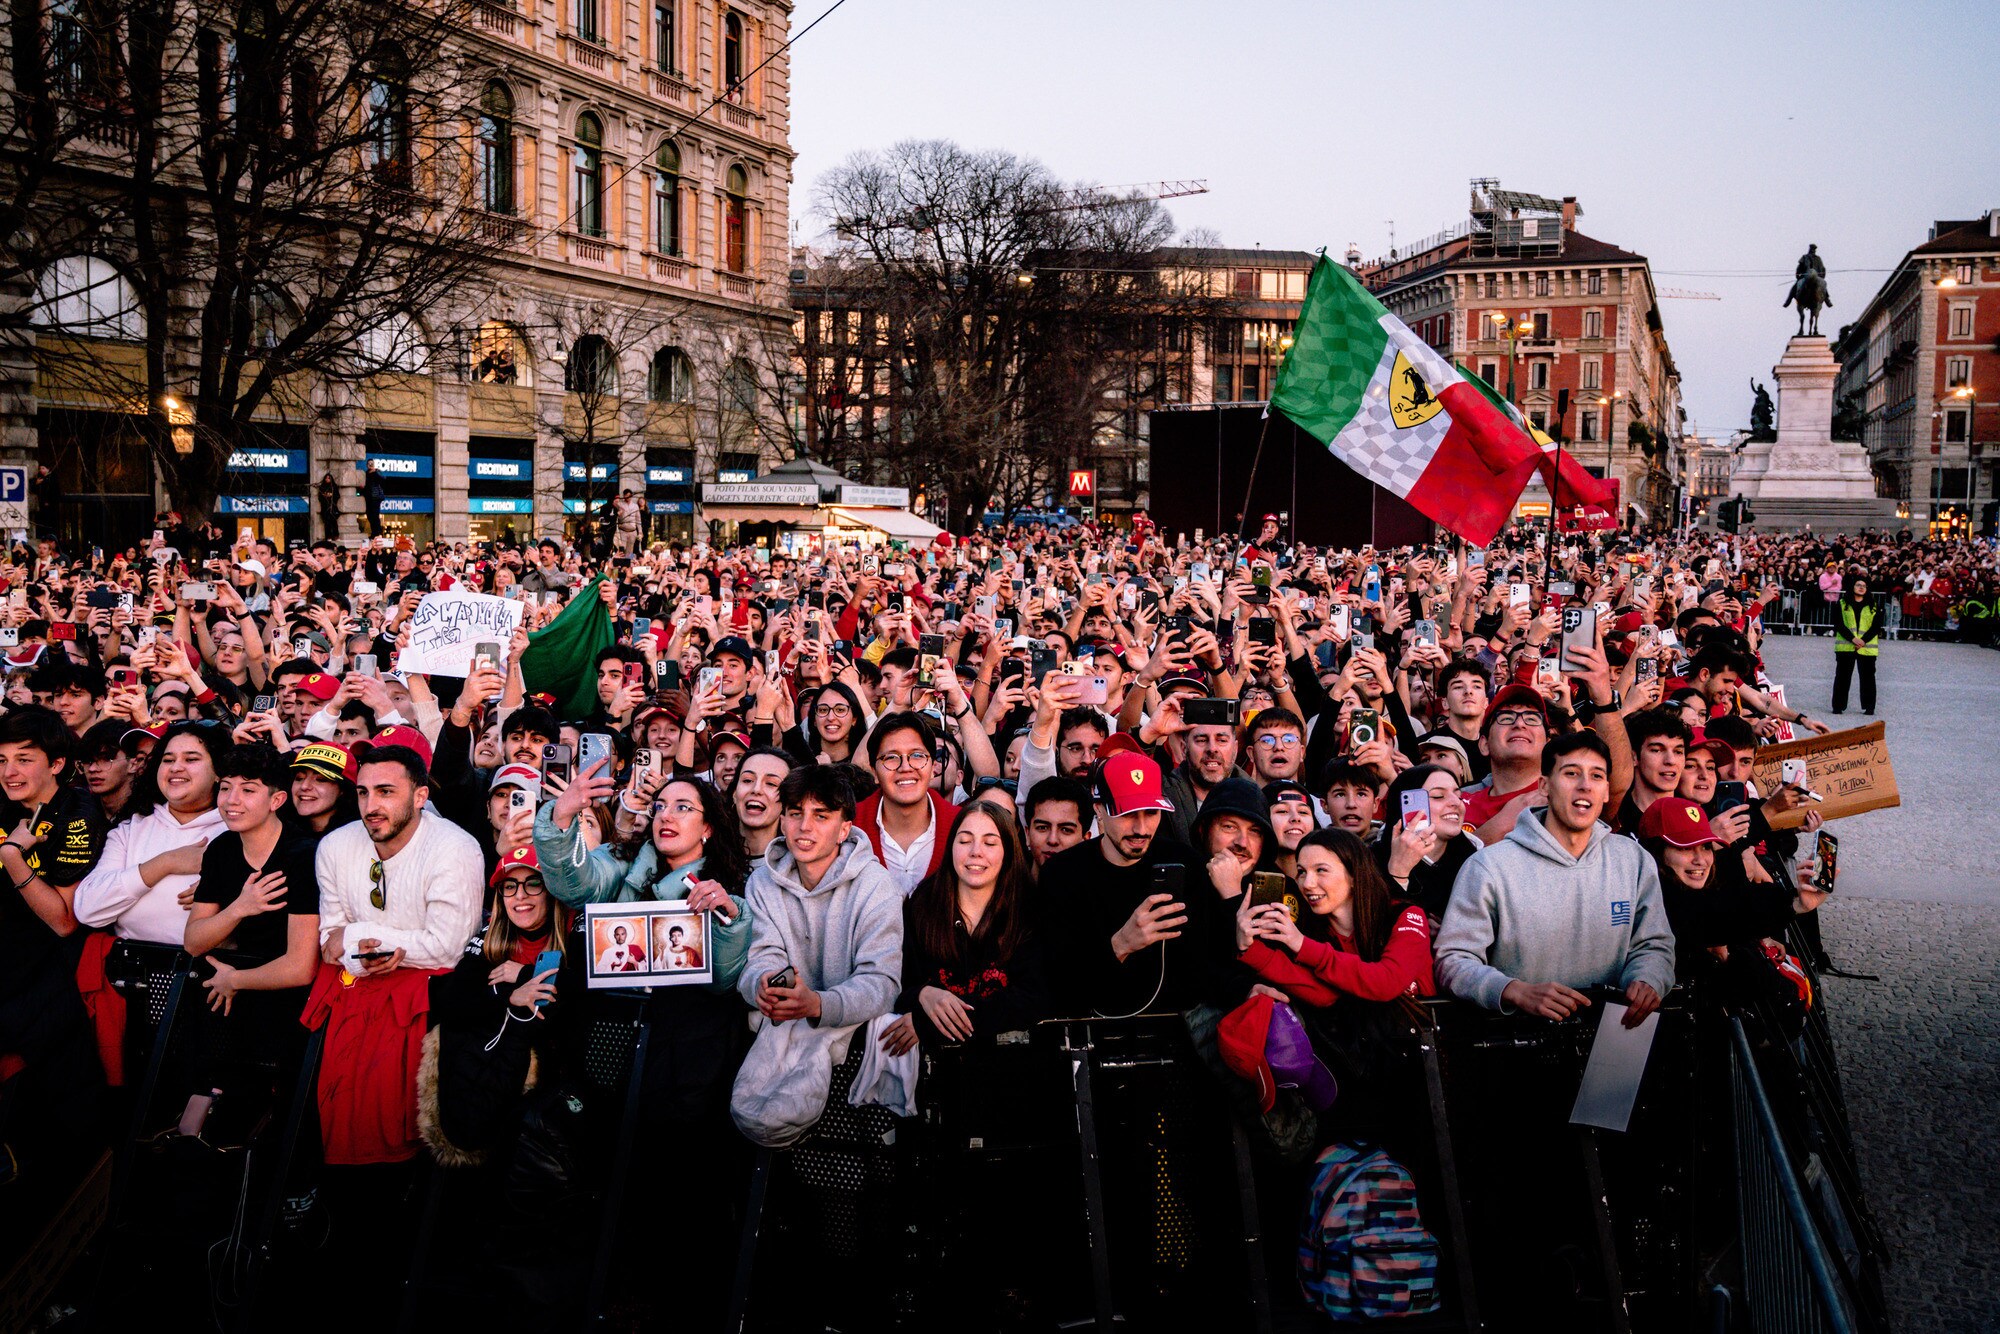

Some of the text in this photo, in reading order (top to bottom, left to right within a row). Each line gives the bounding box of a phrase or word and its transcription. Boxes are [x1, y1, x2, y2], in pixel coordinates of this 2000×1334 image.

[228, 453, 288, 467] DECATHLON
[373, 459, 417, 472] ECATHLON
[477, 463, 519, 475] DECATHLON
[3, 473, 20, 498] P
[714, 485, 807, 493] FOTO FILMS SOUVENIRS
[1071, 474, 1091, 491] M
[232, 498, 289, 511] DECATHLON
[380, 500, 413, 510] ECATHLON
[743, 495, 784, 503] TOURISTIC
[786, 495, 816, 503] GUIDES
[413, 602, 438, 626] LA
[1848, 738, 1875, 751] CAN
[302, 748, 342, 761] Ferrari
[1760, 776, 1780, 796] YOU
[1826, 784, 1833, 795] A
[68, 819, 86, 830] aws
[1406, 912, 1424, 923] aws
